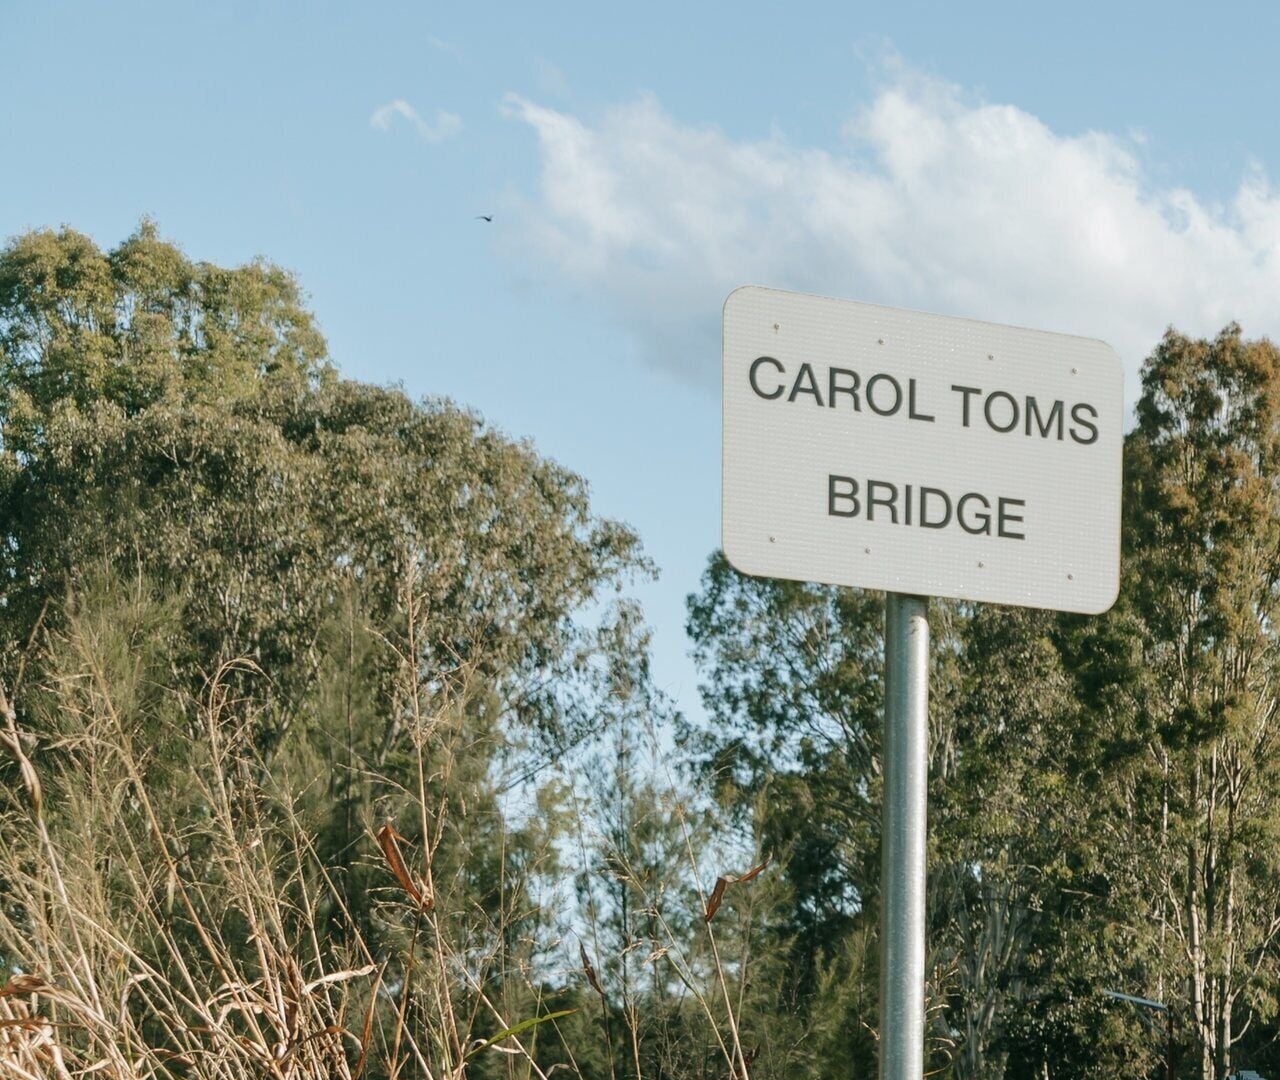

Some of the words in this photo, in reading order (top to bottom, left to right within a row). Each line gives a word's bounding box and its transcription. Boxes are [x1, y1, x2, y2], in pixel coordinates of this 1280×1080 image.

[748, 356, 936, 423] CAROL
[950, 384, 1099, 446] TOMS
[827, 473, 1026, 541] BRIDGE
